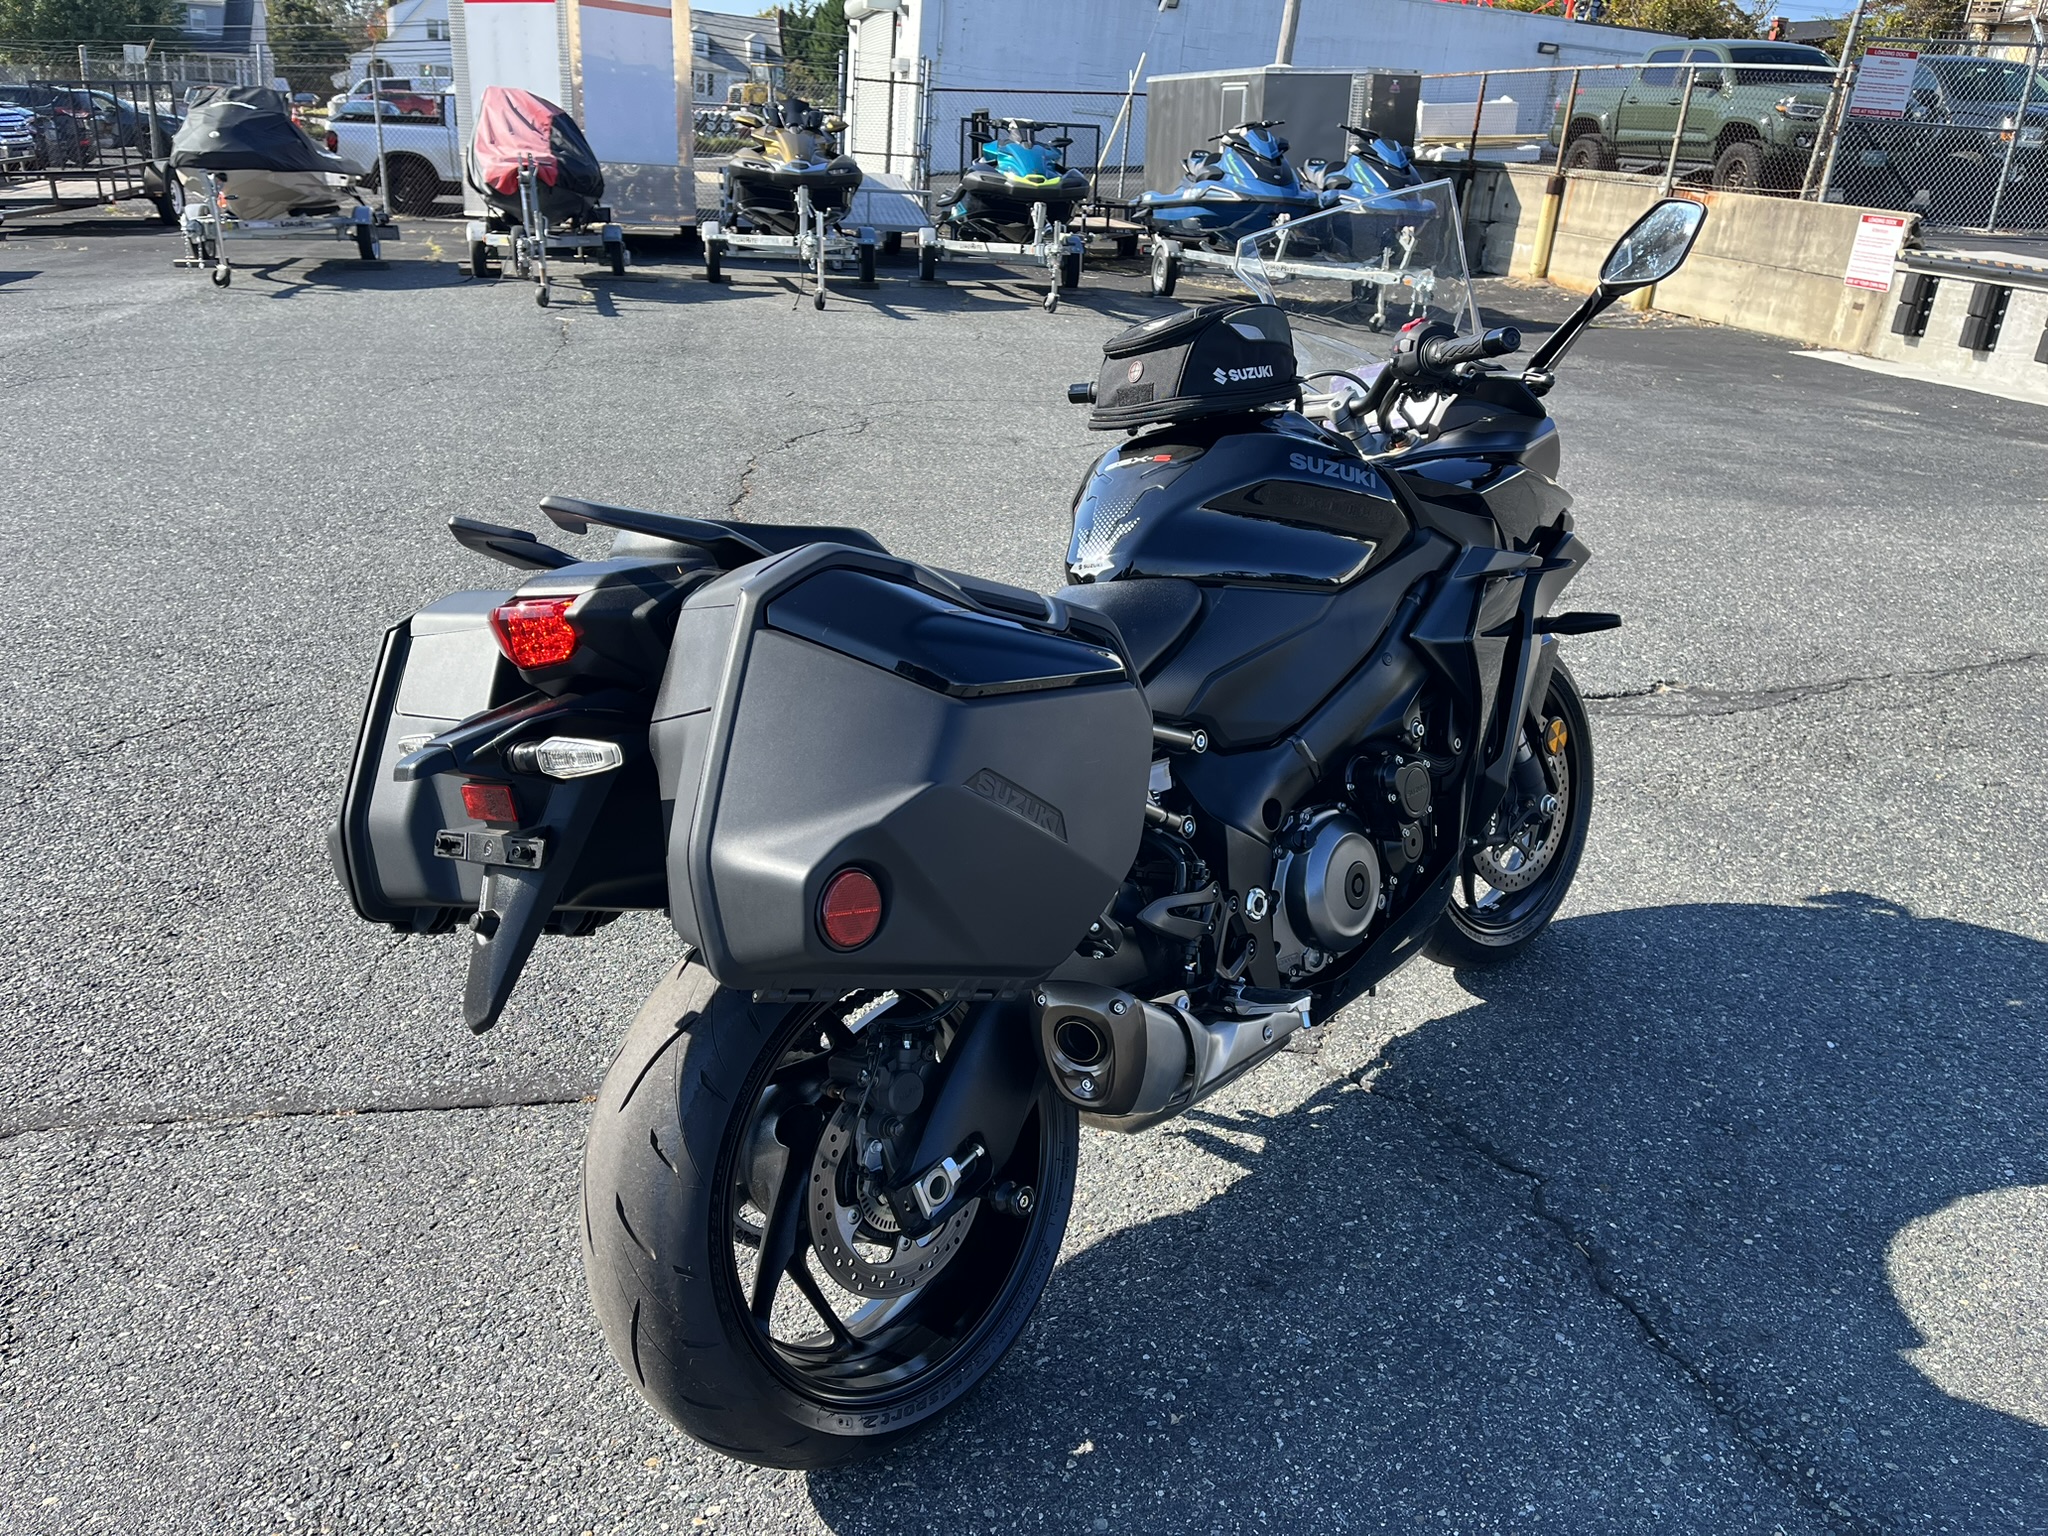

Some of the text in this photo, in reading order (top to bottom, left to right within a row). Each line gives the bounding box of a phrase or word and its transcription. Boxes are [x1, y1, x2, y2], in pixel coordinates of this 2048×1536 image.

[1228, 365, 1274, 382] SUZUKI
[1289, 452, 1377, 489] SUZUKI
[976, 772, 1063, 837] SUZUKI
